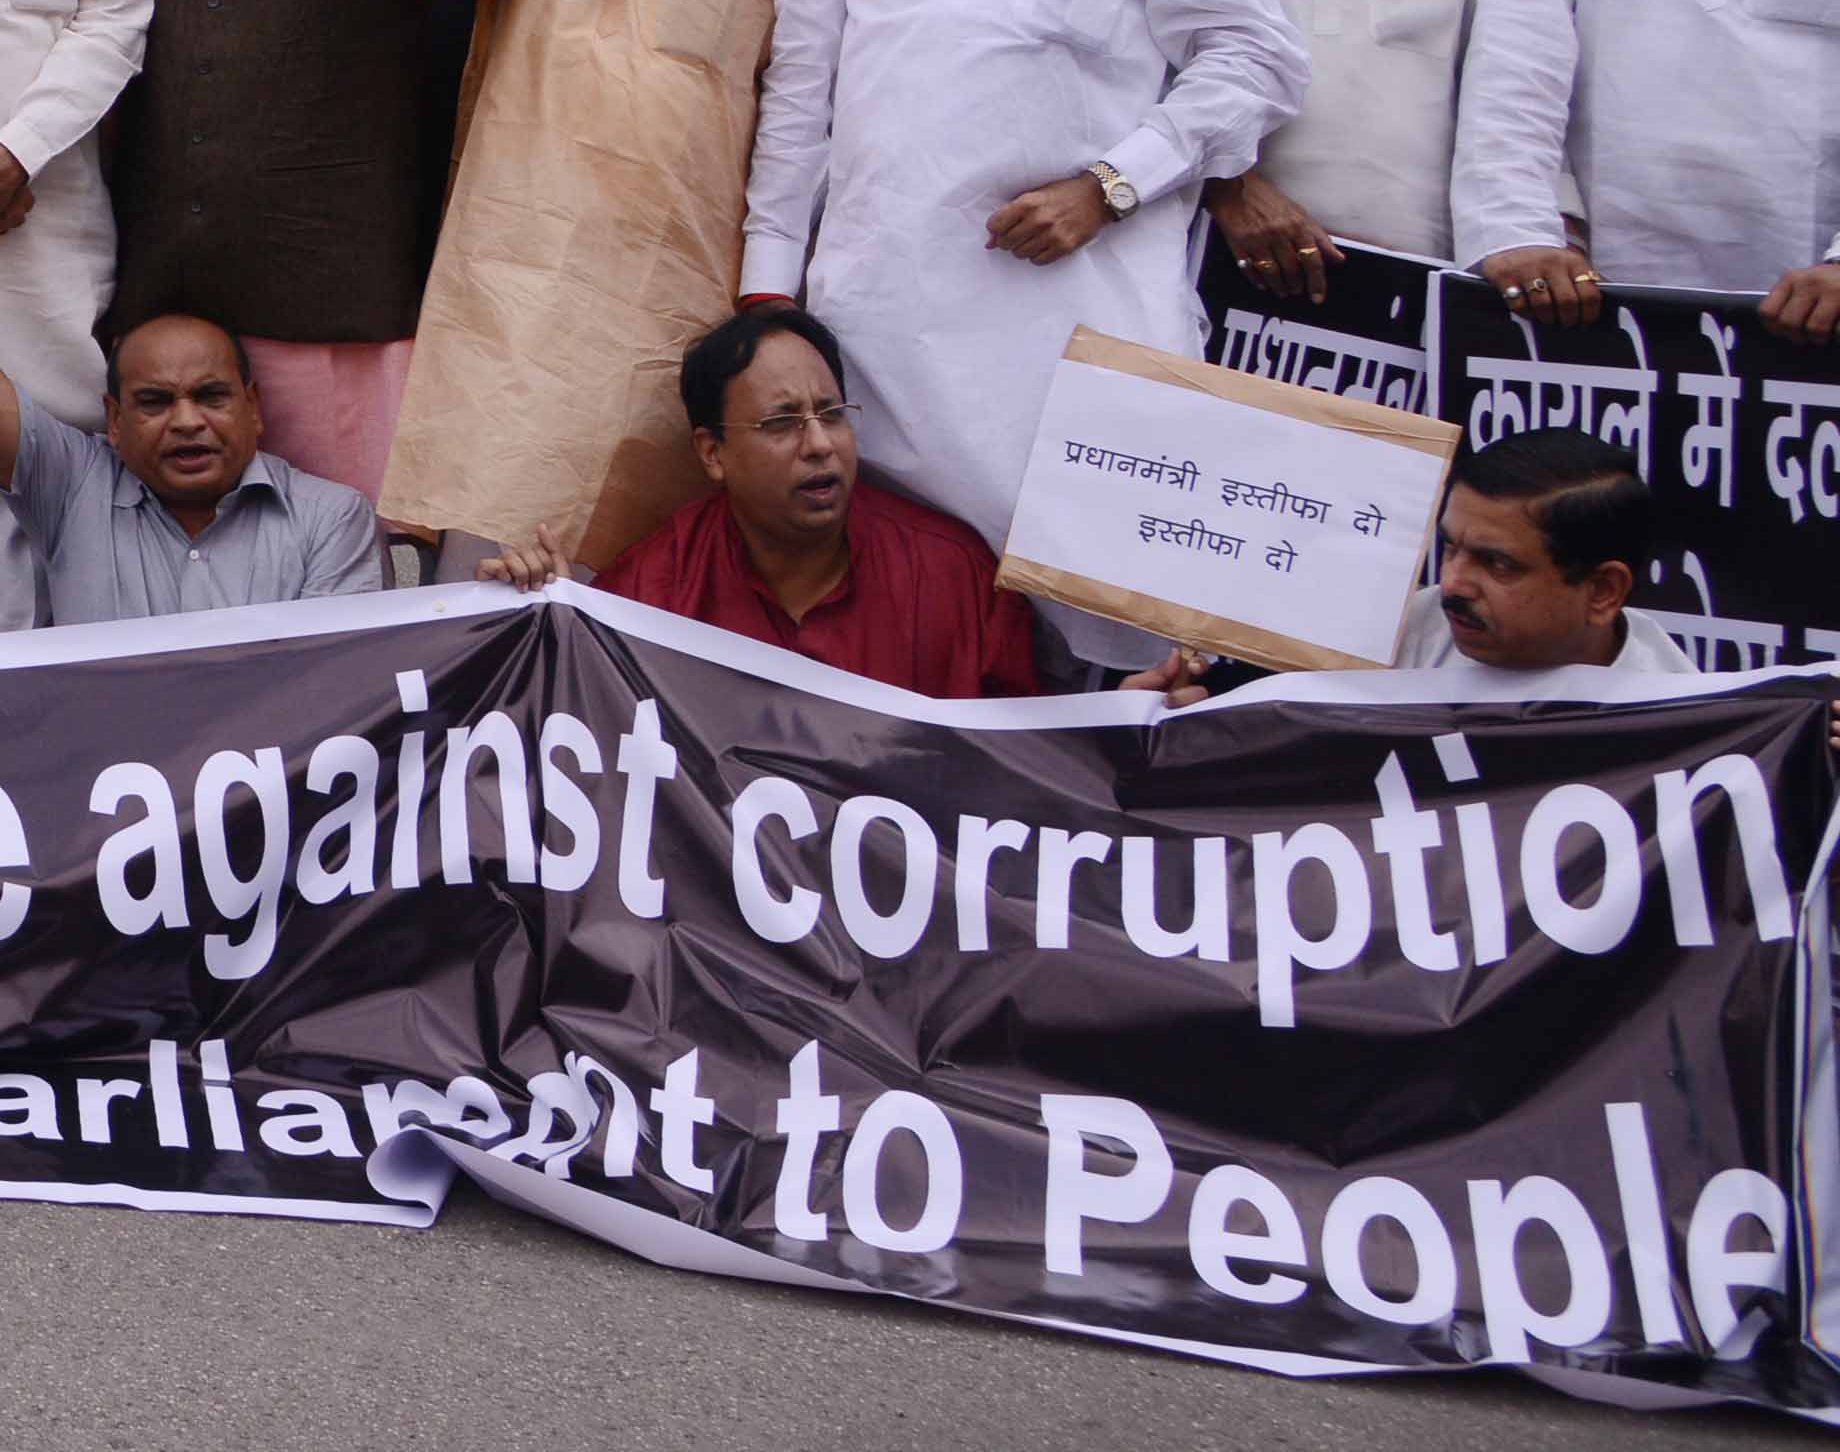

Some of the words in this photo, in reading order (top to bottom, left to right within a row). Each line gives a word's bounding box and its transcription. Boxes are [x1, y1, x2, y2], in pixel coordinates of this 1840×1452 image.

[1064, 440, 1200, 492] प्रधानमंत्री
[1220, 476, 1332, 524] इस्तीफा
[1353, 504, 1386, 537] दो
[1678, 311, 1741, 508] में
[1138, 513, 1246, 560] इस्तीफा
[1265, 540, 1298, 573] दो
[88, 669, 677, 979] against
[730, 732, 1794, 1029] corruption
[774, 1038, 963, 1253] to
[1039, 1093, 1788, 1364] People
